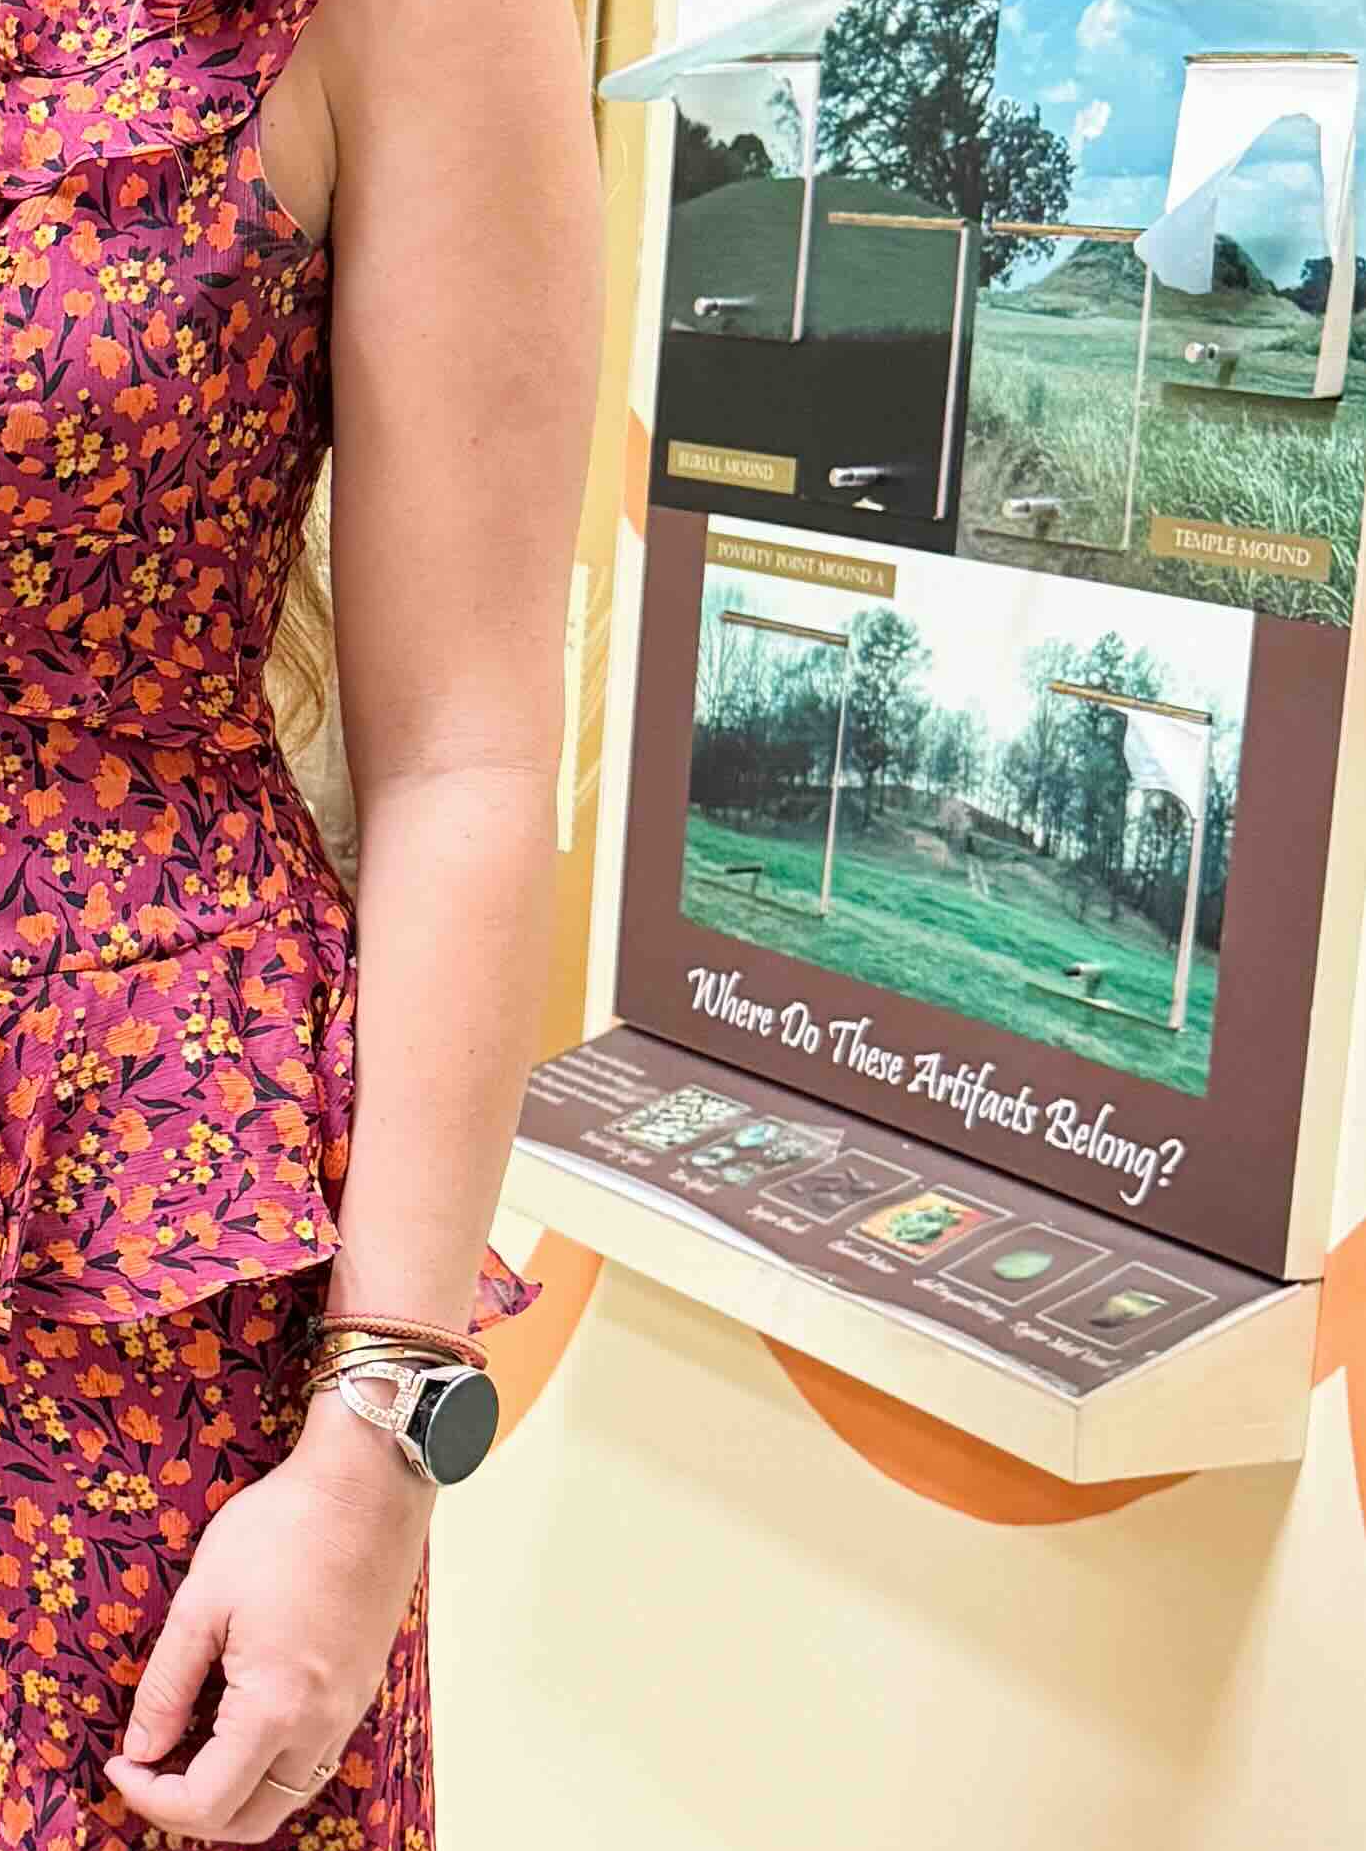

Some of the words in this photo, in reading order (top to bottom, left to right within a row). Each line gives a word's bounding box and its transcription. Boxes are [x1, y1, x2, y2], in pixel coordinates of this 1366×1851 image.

[722, 460, 774, 481] MOUND
[718, 541, 771, 566] POVERTY
[776, 553, 816, 575] POINT
[818, 558, 873, 584] MOUND
[874, 571, 884, 588] A
[1173, 528, 1236, 555] TEMPLE
[1238, 538, 1309, 567] MOUND
[688, 967, 773, 1036] Where
[780, 1002, 820, 1055] Do
[829, 1018, 902, 1086] These
[906, 1051, 1039, 1135] Artifacts
[1044, 1098, 1185, 1206] Belong?
